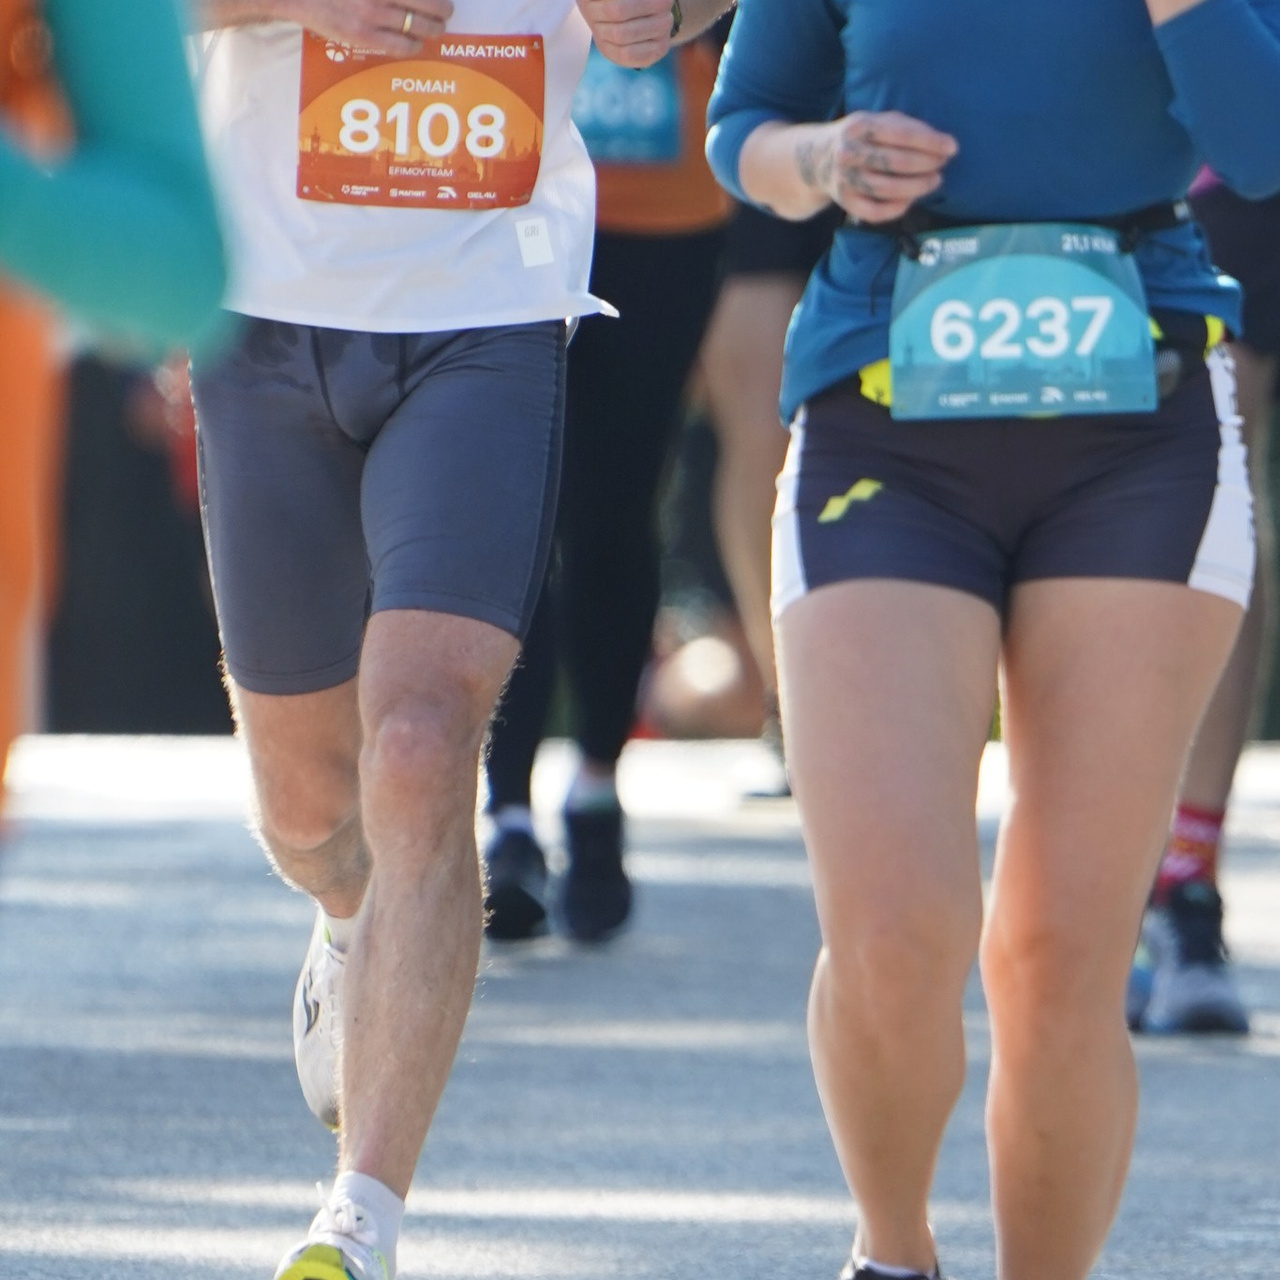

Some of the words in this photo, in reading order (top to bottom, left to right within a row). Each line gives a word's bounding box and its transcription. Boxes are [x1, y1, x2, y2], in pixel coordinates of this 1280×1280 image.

[440, 43, 526, 58] MARATHON
[391, 77, 456, 94] РОМАН
[338, 98, 506, 158] 8108
[388, 166, 454, 177] EFIMOVTEAM
[930, 295, 1114, 362] 6237
